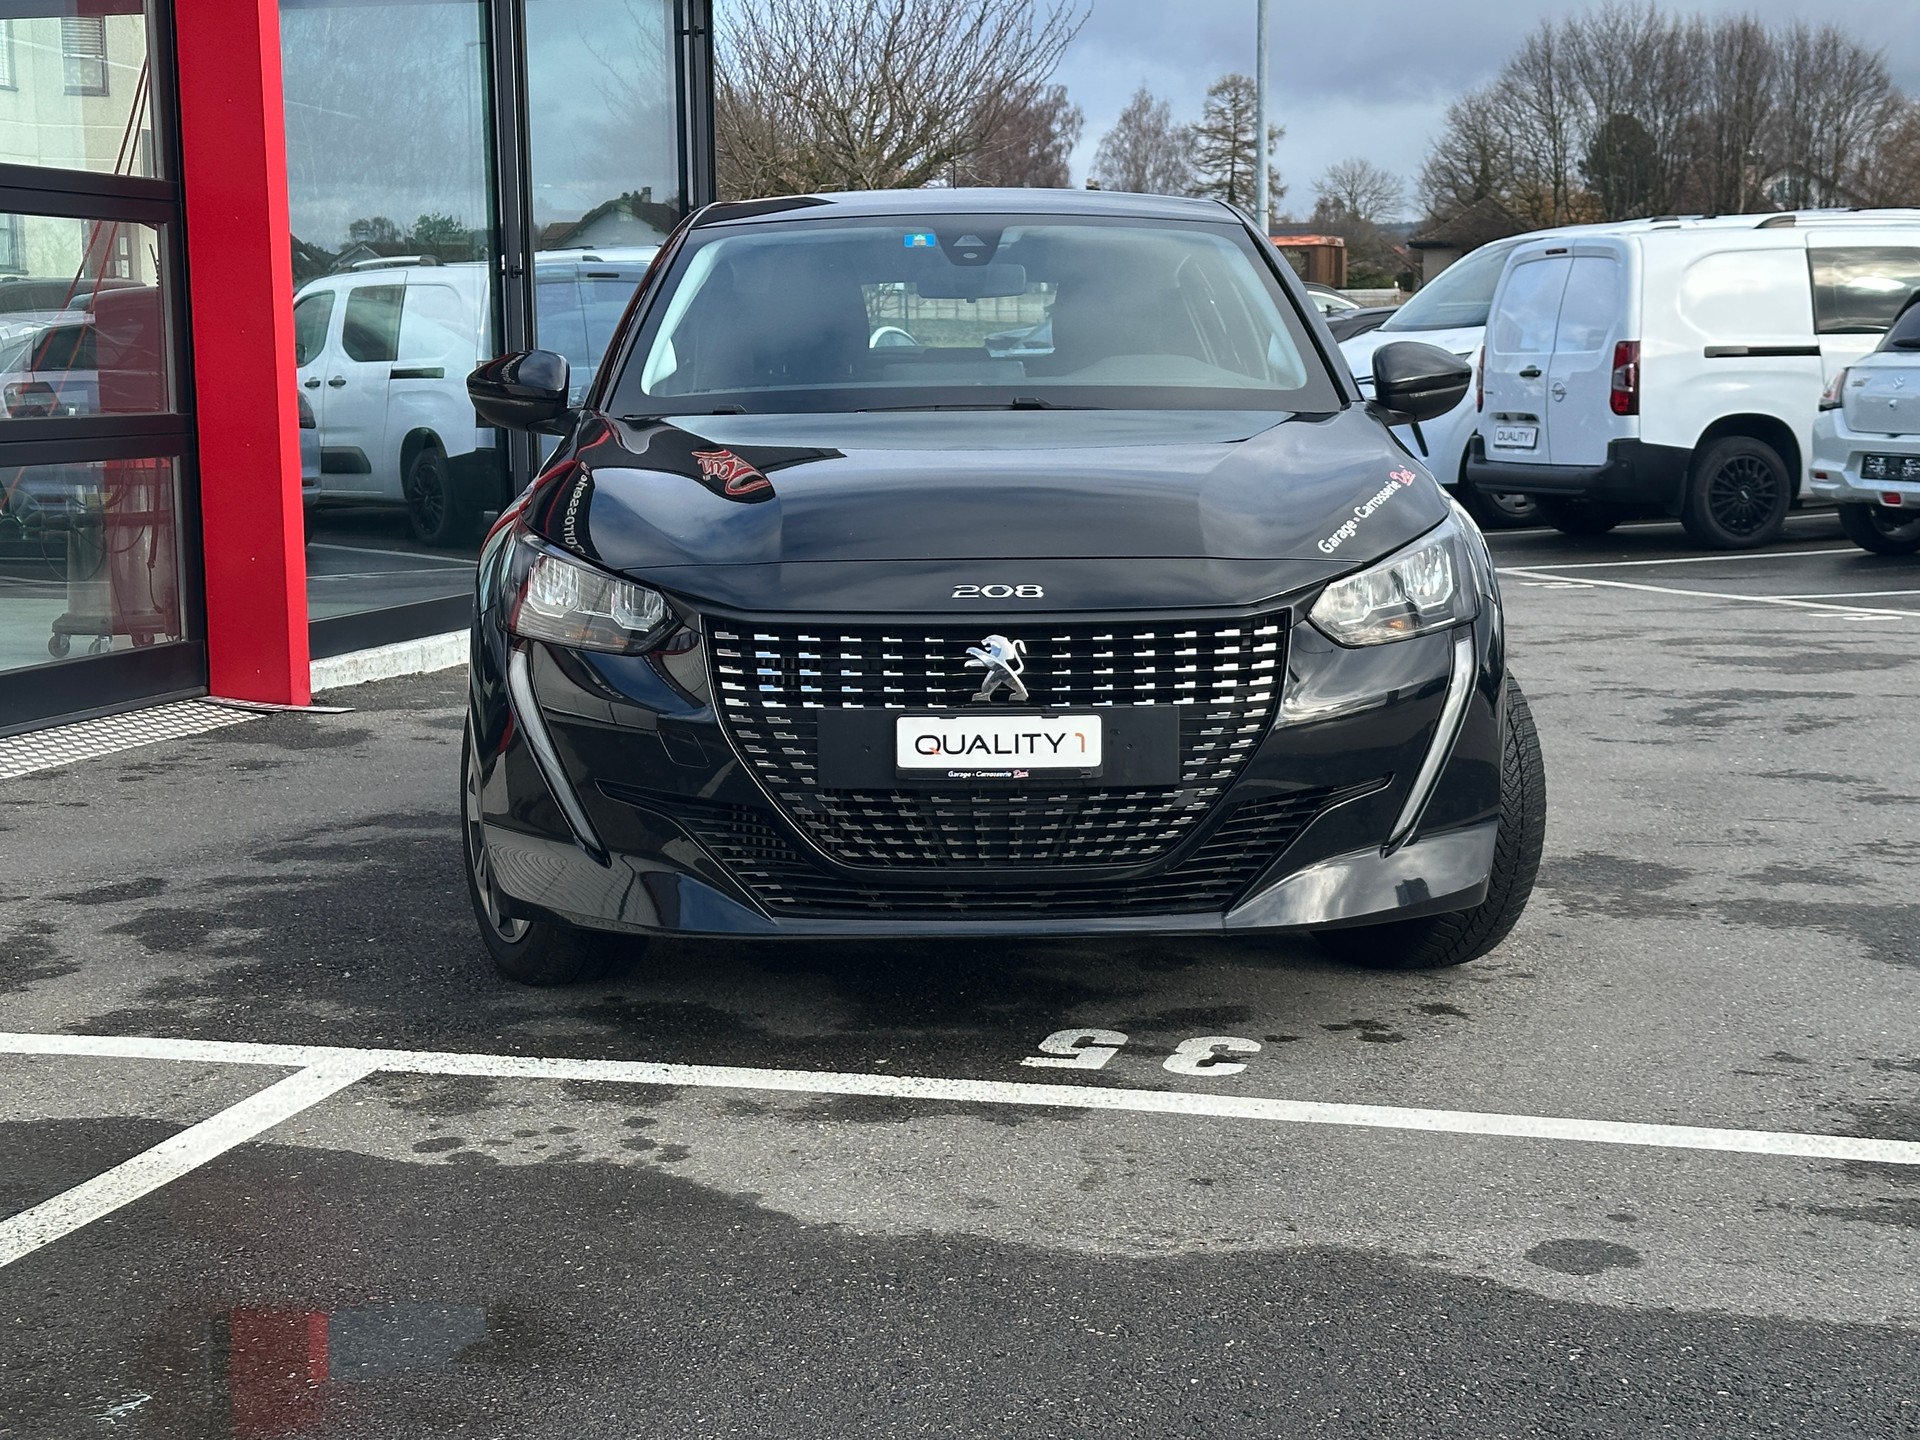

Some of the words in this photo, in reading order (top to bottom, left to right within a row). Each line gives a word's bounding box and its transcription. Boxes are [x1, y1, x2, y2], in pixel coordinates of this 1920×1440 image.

[1497, 431, 1529, 442] QUALITY
[1317, 520, 1358, 553] Garage
[1354, 481, 1402, 518] Carrosserie
[951, 584, 1045, 598] 208
[915, 733, 1067, 755] QUALITY
[1074, 732, 1086, 753] 1
[948, 770, 972, 779] Garage
[976, 770, 1012, 778] Carrosserie
